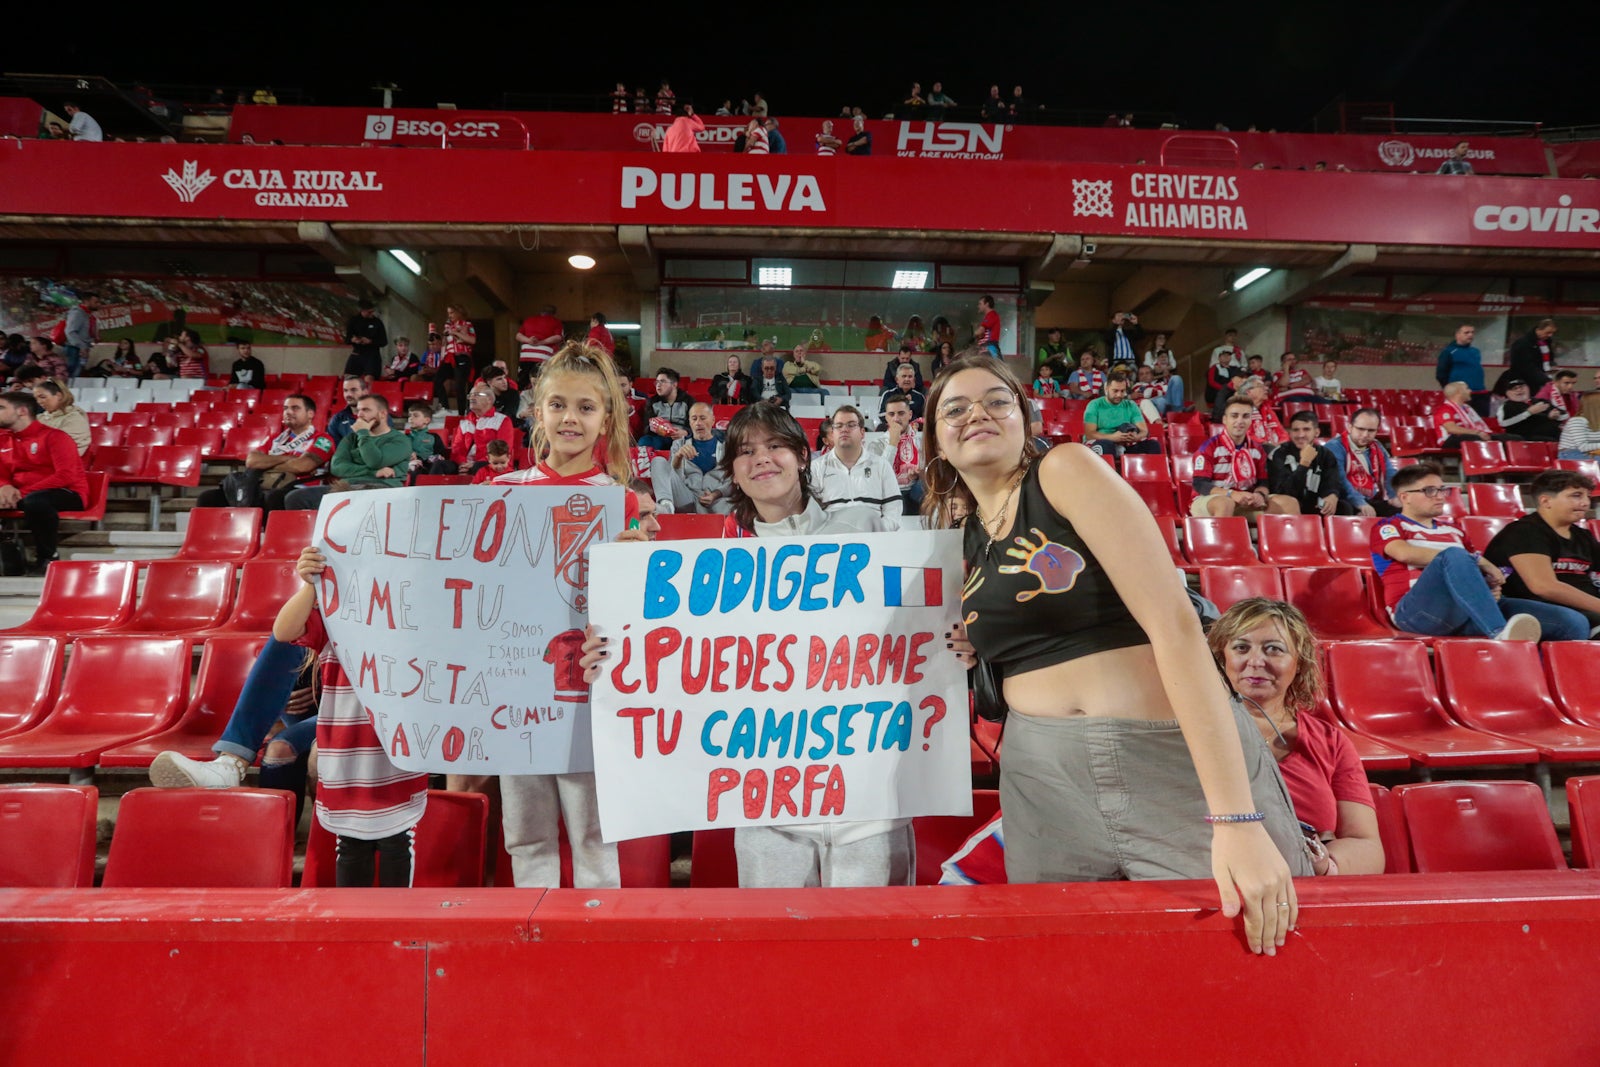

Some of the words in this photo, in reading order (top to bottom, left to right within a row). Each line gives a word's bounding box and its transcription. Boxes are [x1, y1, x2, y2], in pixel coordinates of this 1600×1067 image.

[897, 150, 916, 158] WE
[919, 151, 941, 159] ARE
[943, 151, 1004, 161] NUTRITION!
[1415, 147, 1496, 160] VADISGUR
[222, 168, 287, 190] CAJA
[292, 169, 383, 191] RURAL
[620, 166, 827, 212] PULEVA
[1130, 172, 1239, 201] CERVEZAS
[254, 191, 349, 208] GRANADA
[1124, 202, 1248, 231] ALHAMBRA
[323, 488, 551, 568] CALLEJÓN
[643, 542, 871, 619] BODIGER
[320, 564, 418, 631] DAME
[444, 577, 504, 631] TU
[500, 620, 544, 640] SOMOS
[487, 644, 541, 661] ISABELLA
[610, 623, 798, 695] ¿PUEDES
[806, 631, 935, 692] DARME
[486, 666, 527, 679] AGATHA
[490, 703, 565, 730] CUMPLO
[616, 707, 683, 759] TU
[700, 694, 947, 761] CAMISETA?
[707, 763, 846, 822] PORFA
